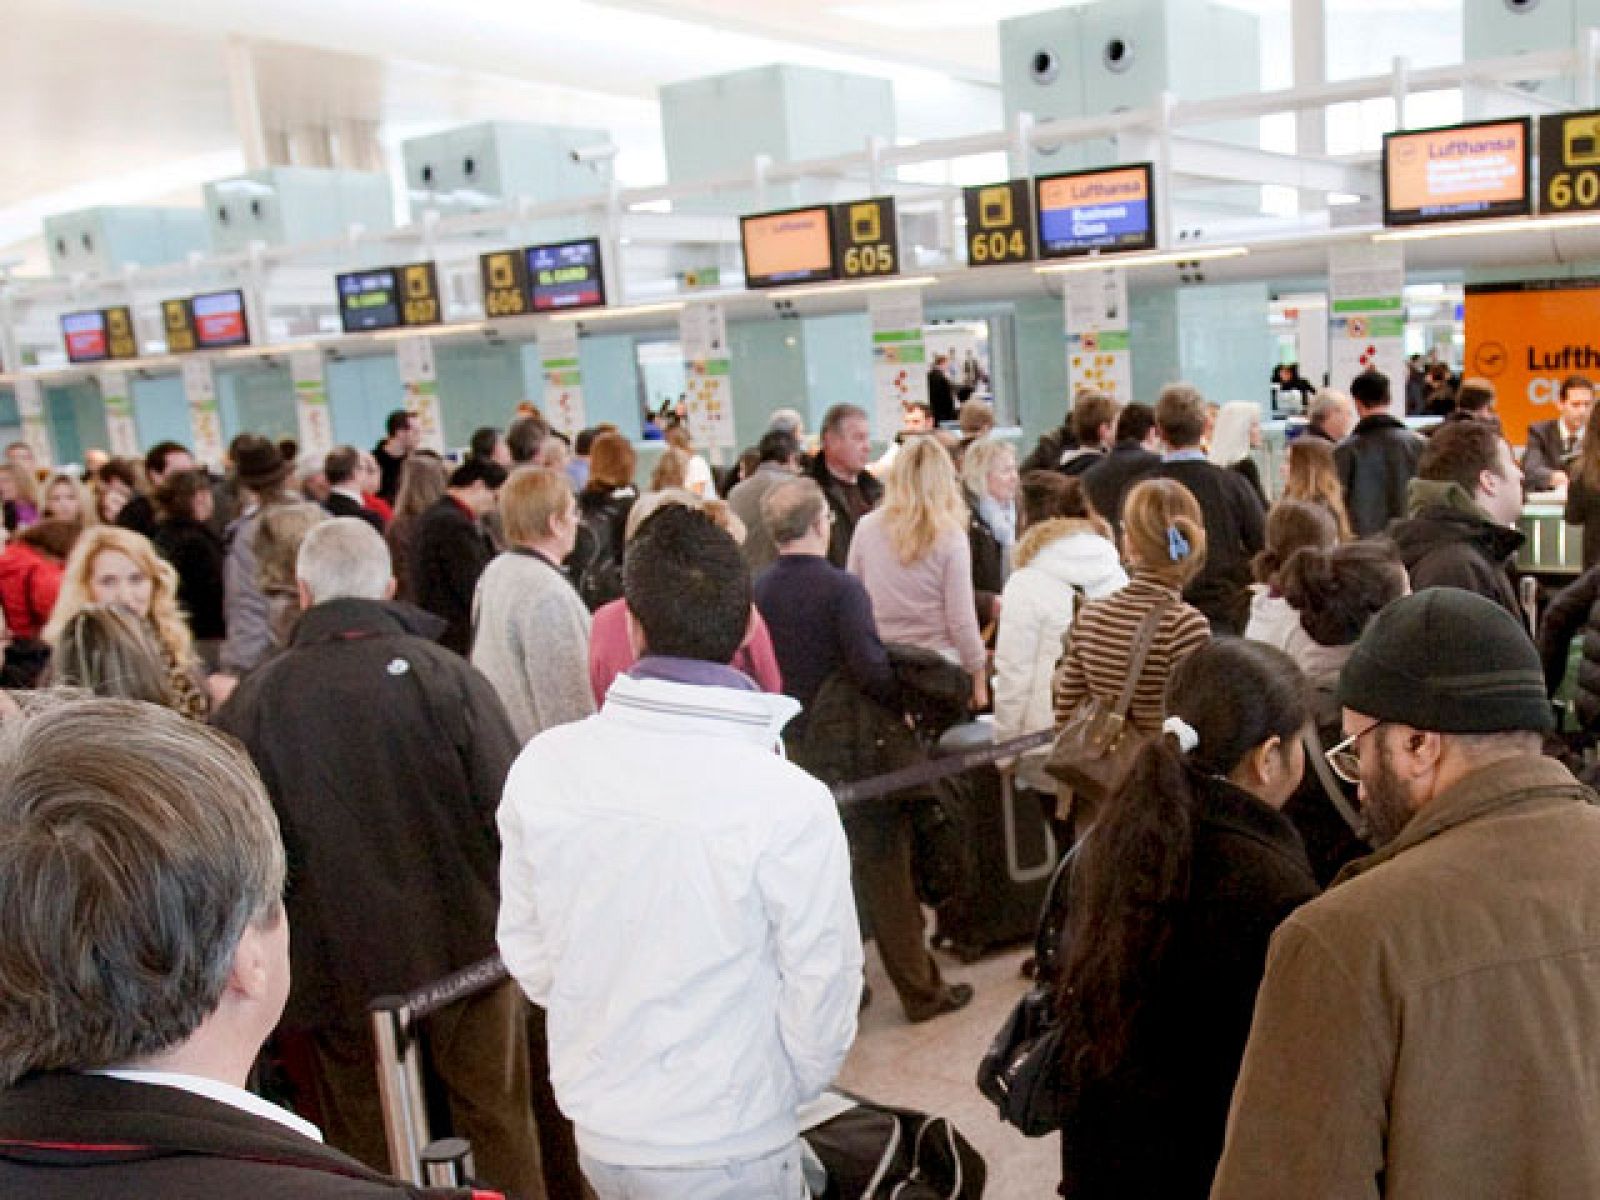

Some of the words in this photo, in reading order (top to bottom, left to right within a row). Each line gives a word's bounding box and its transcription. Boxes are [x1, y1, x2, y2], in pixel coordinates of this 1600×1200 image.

[1427, 137, 1517, 159] Lufthansa
[1070, 179, 1142, 199] Lufthansa
[971, 229, 1027, 262] 604
[844, 244, 894, 276] 605
[487, 289, 525, 315] 606
